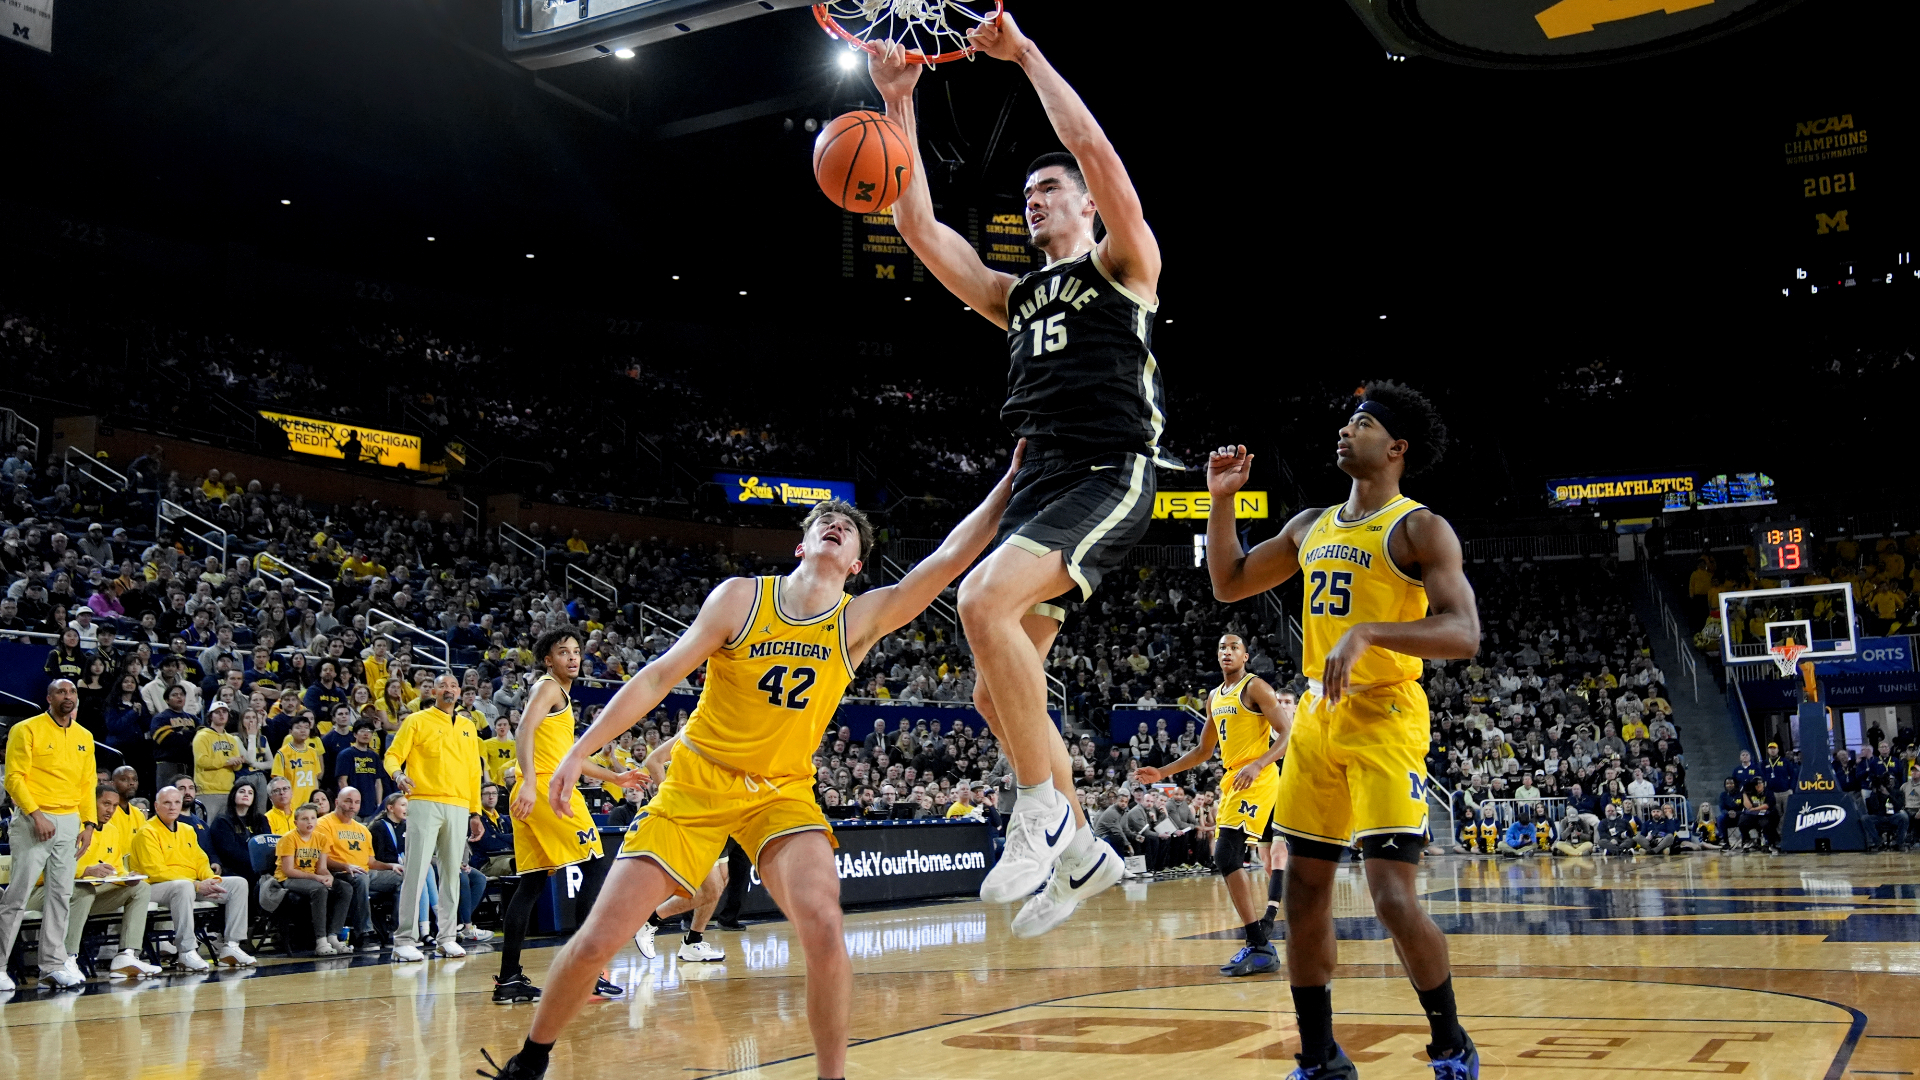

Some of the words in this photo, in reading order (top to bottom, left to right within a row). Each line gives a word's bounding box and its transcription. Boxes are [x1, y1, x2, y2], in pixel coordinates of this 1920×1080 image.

[12, 22, 30, 40] M
[1795, 113, 1855, 138] NCAA
[1784, 129, 1868, 155] CHAMPIONS
[1786, 152, 1820, 166] WOMEN'S
[1821, 144, 1868, 161] GYMNASTICS
[855, 181, 875, 202] M
[1803, 171, 1857, 198] 2021
[862, 215, 894, 226] CHAMPI
[992, 213, 1024, 224] NCAA
[1815, 208, 1850, 236] M
[862, 243, 908, 254] GYMNASTICS
[867, 234, 903, 245] WOMEN'S
[992, 243, 1026, 254] WOMEN'S
[986, 252, 1032, 264] GYMNASTICS
[874, 263, 896, 280] M
[1012, 275, 1099, 332] PURDUE
[1030, 312, 1068, 357] 15
[360, 431, 419, 449] MICHIGAN
[361, 443, 390, 457] NION
[780, 483, 832, 504] JEWELERS
[1555, 477, 1694, 501] @UMICHATHLETICS
[1160, 498, 1259, 512] ISSN
[1767, 528, 1802, 545] 13:13
[1304, 544, 1373, 571] MICHIGAN
[1778, 543, 1800, 570] 13
[1310, 570, 1353, 617] 25
[749, 641, 832, 661] MICHIGAN
[757, 665, 817, 710] 42
[1831, 686, 1865, 695] FAMILY
[1878, 682, 1918, 693] TUNNEL
[1219, 718, 1227, 741] 4
[498, 748, 511, 759] M
[296, 770, 314, 787] 24
[1799, 780, 1835, 791] UMCU
[1408, 771, 1429, 806] M
[1238, 799, 1258, 818] M
[1795, 808, 1842, 833] LIBMAN
[576, 828, 597, 845] M
